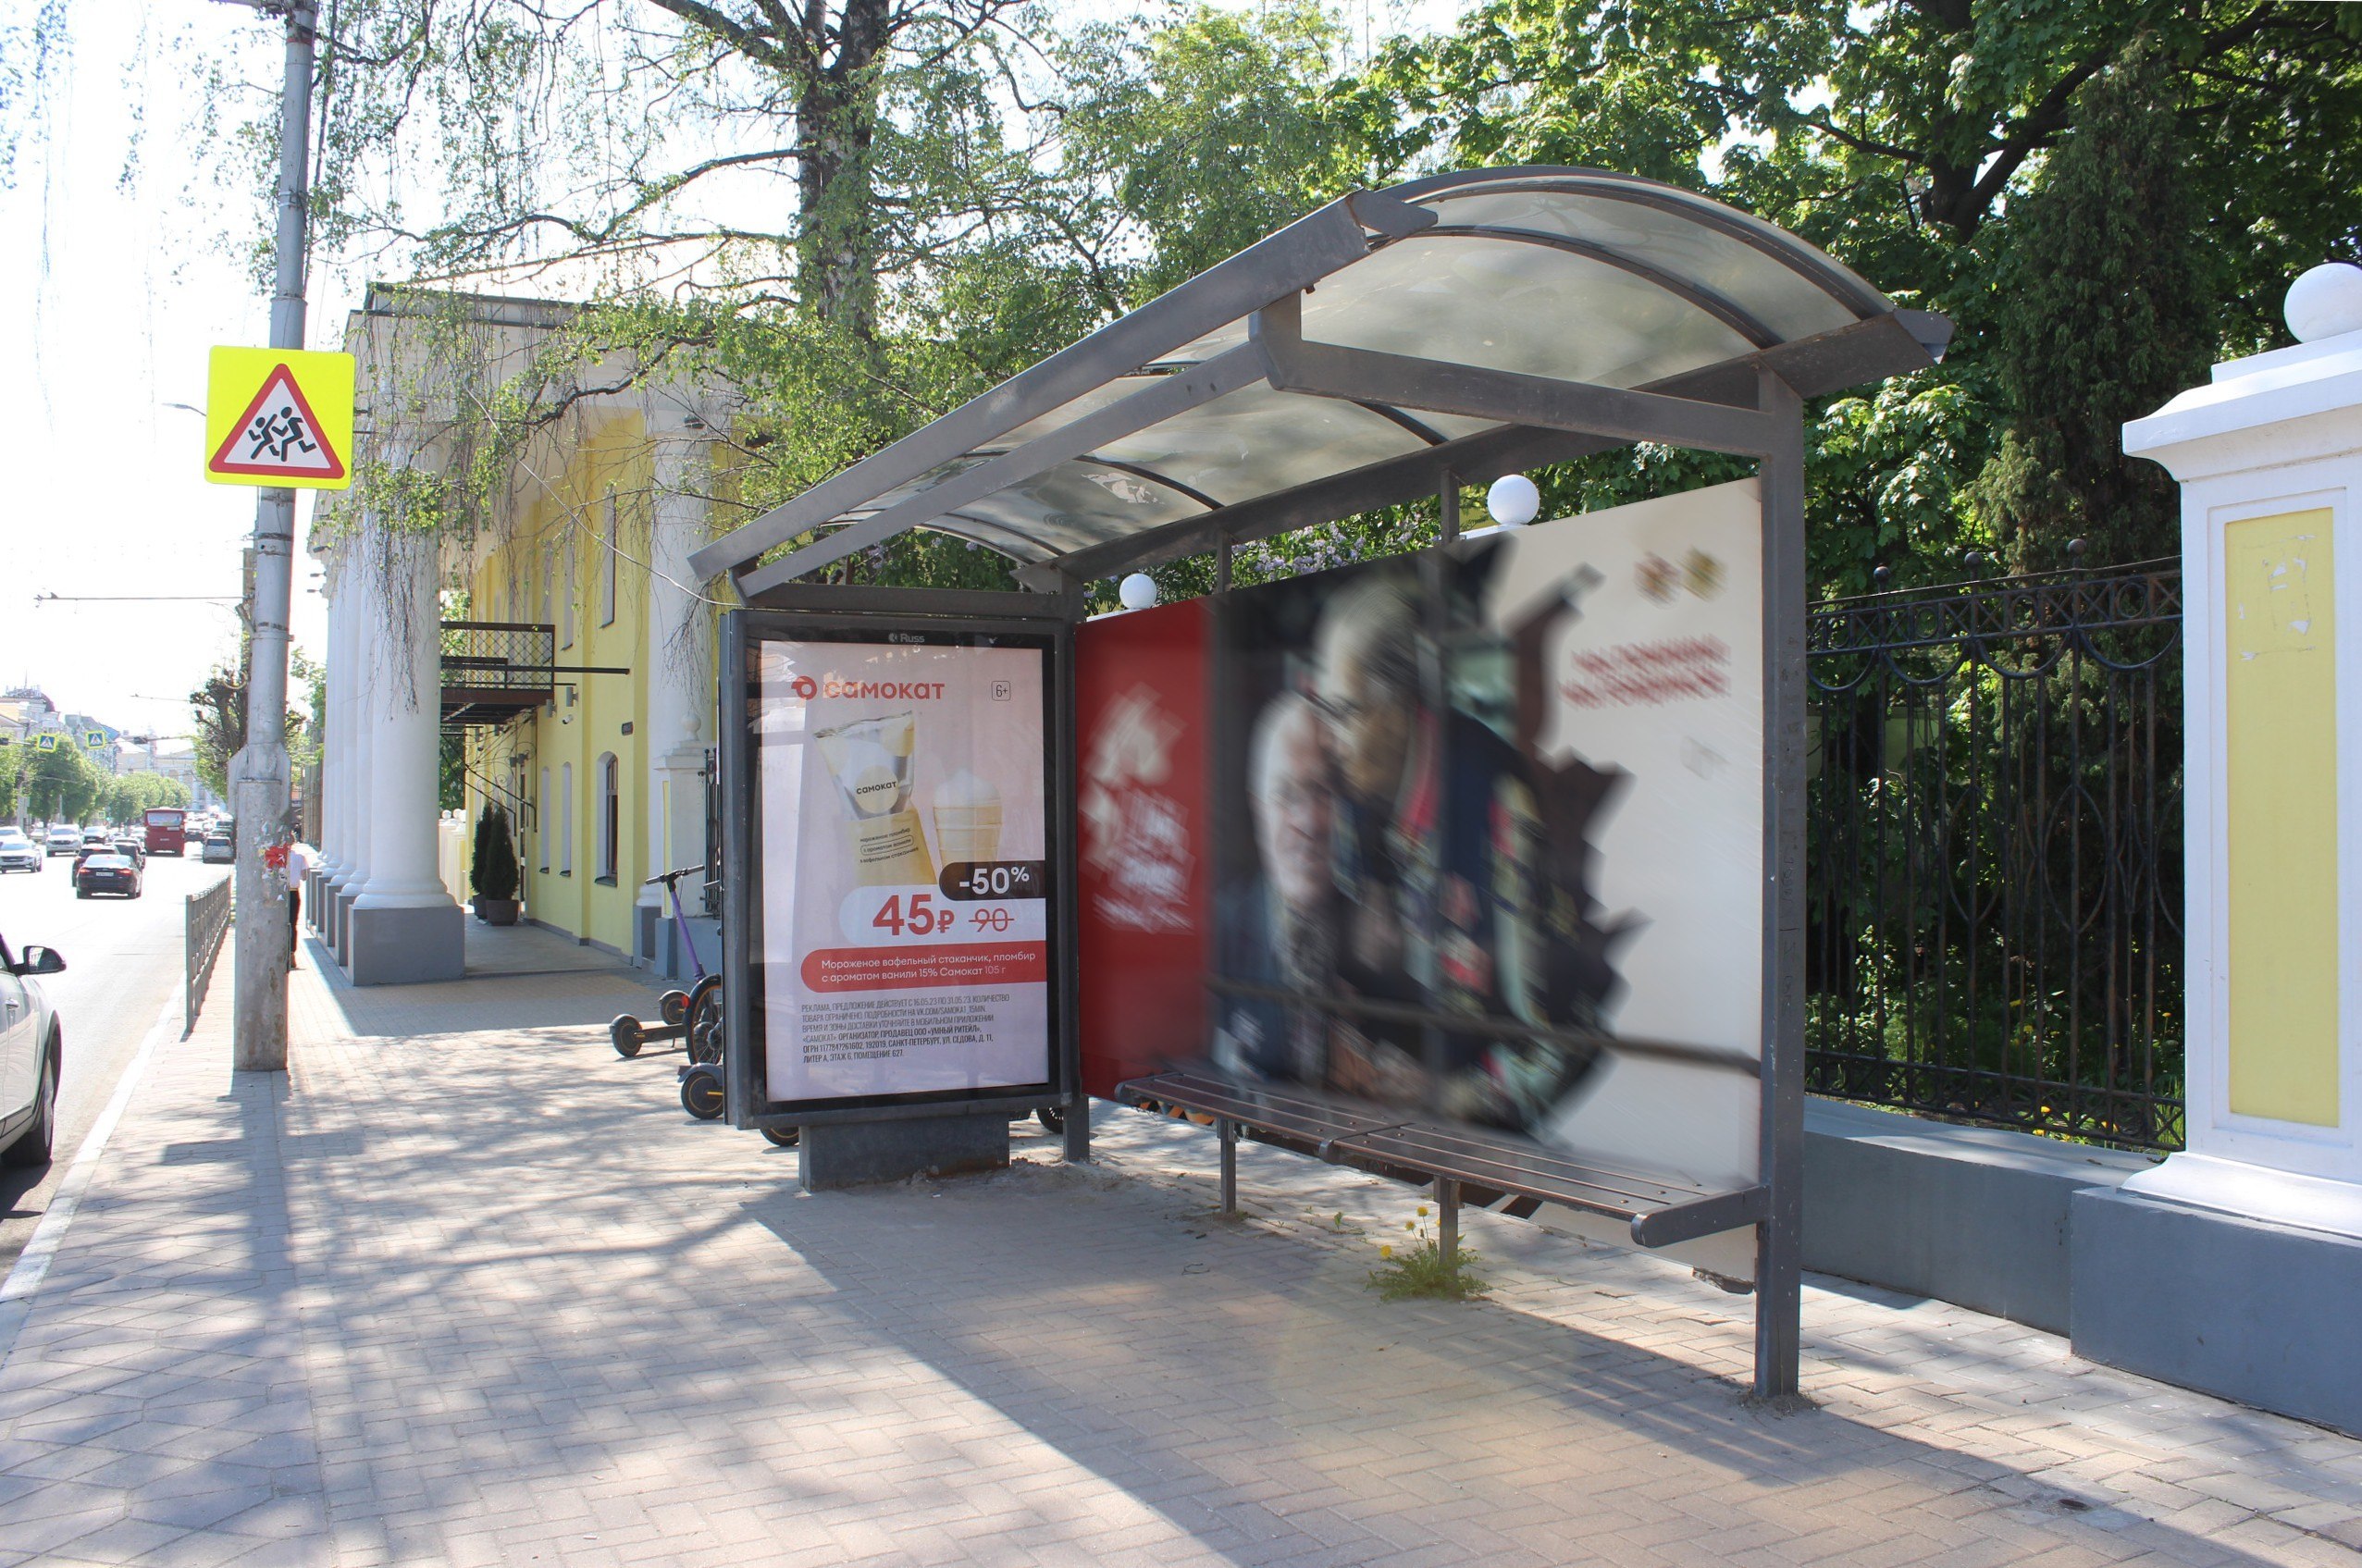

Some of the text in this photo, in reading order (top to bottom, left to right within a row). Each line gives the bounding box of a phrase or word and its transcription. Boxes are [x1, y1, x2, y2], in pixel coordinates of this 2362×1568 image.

[900, 634, 925, 643] Russ
[825, 681, 945, 699] самокат
[996, 685, 1008, 697] 6+
[856, 781, 897, 795] самокат
[959, 866, 1030, 895] -50%
[972, 907, 1010, 932] 90
[822, 951, 1036, 969] Мороженое вафельный стаканчик, пломбир
[830, 972, 880, 983] ароматом
[882, 970, 917, 979] ванили
[919, 968, 938, 977] 15%
[940, 967, 983, 976] Самокат
[984, 965, 1000, 974] 105
[832, 1000, 876, 1011] ПРЕДЛОЖЕНИЕ
[972, 994, 1010, 1004] КОЛИЧЕСТВО
[802, 1014, 824, 1023] ТОВАРА
[864, 1009, 907, 1019] ПОДРОБНОСТИ
[908, 1008, 916, 1016] НА
[803, 1024, 823, 1033] ВРЕМЯ
[847, 1020, 878, 1031] ДОСТАВКИ
[880, 1028, 914, 1038] ПРОДАВЕЦ
[914, 1027, 927, 1036] ООО
[927, 1025, 954, 1036] «УМНЫЙ
[803, 1045, 819, 1054] ОГРН
[952, 1035, 978, 1044] СЕДОВА,
[803, 1055, 822, 1063] ЛИТЕР
[830, 1053, 847, 1062] ЭТАЖ
[853, 1050, 891, 1060] ПОМЕЩЕНИЕ
